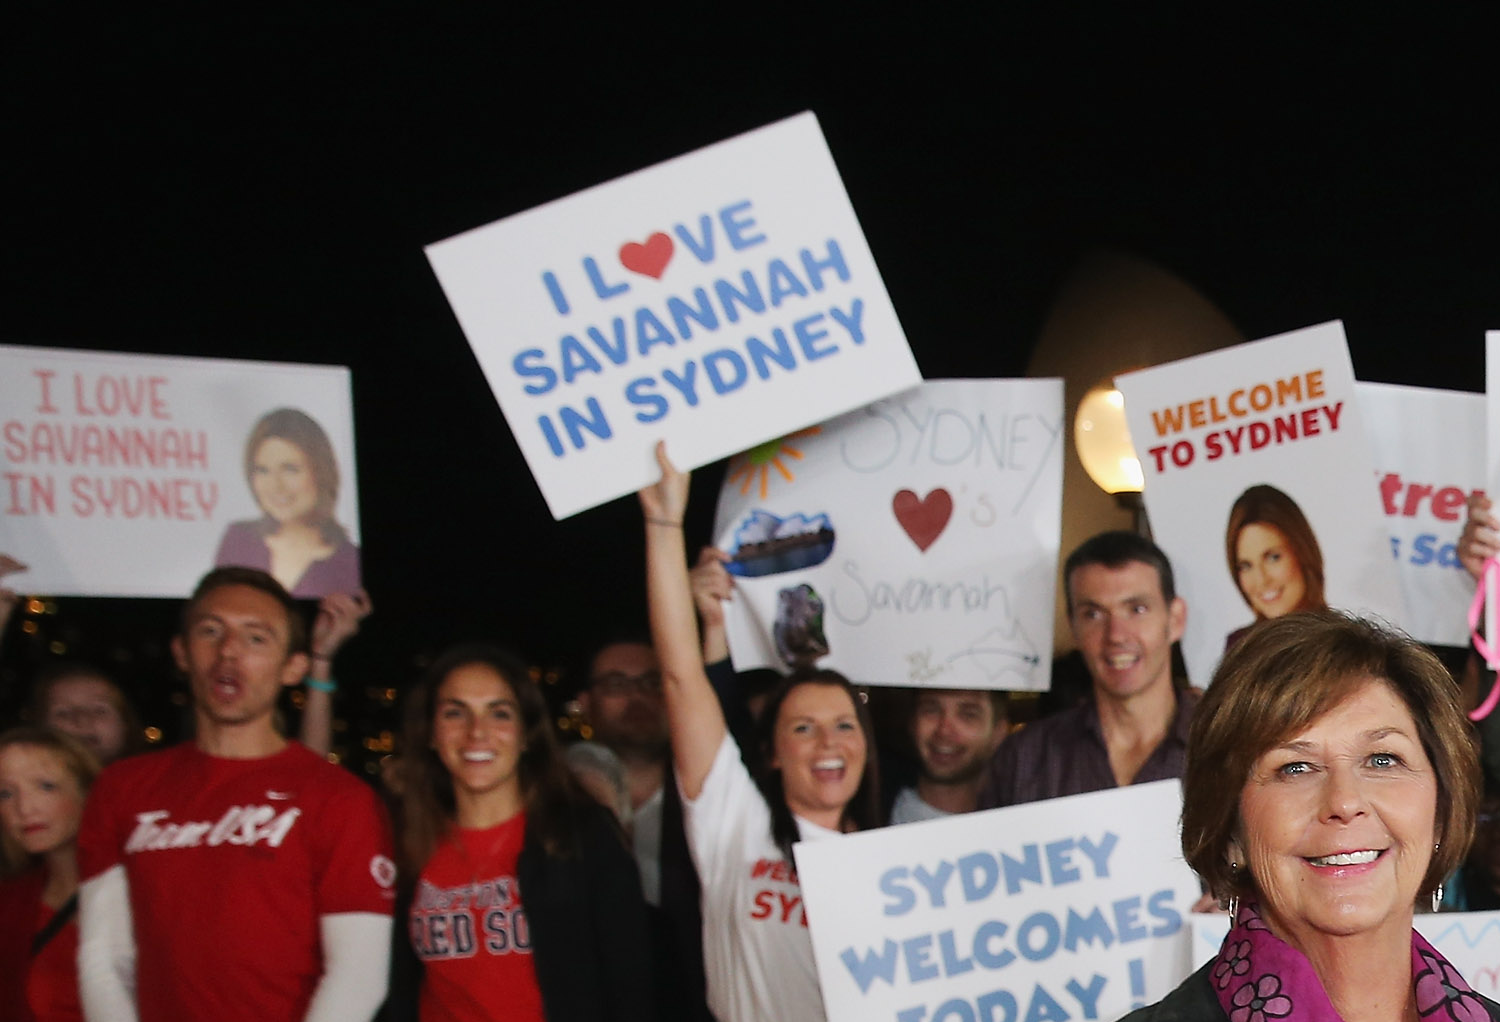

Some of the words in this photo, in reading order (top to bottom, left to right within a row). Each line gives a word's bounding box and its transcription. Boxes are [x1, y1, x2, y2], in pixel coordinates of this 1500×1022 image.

[512, 238, 852, 397] SAVANNAH
[543, 270, 571, 316] I
[33, 368, 60, 415] I
[74, 373, 173, 420] LOVE
[537, 396, 613, 458] IN
[623, 297, 868, 425] SYDNEY
[1151, 368, 1328, 438] WELCOME
[2, 420, 210, 470] SAVANNAH
[840, 399, 1063, 516] SYDNEY
[1148, 439, 1196, 474] TO
[1204, 401, 1345, 462] SYDNEY
[4, 472, 57, 516] IN
[70, 474, 220, 522] SYDNEY
[829, 560, 1013, 627] Savannah
[879, 830, 1120, 918] SYDNEY
[838, 889, 1183, 997] WELCOMES
